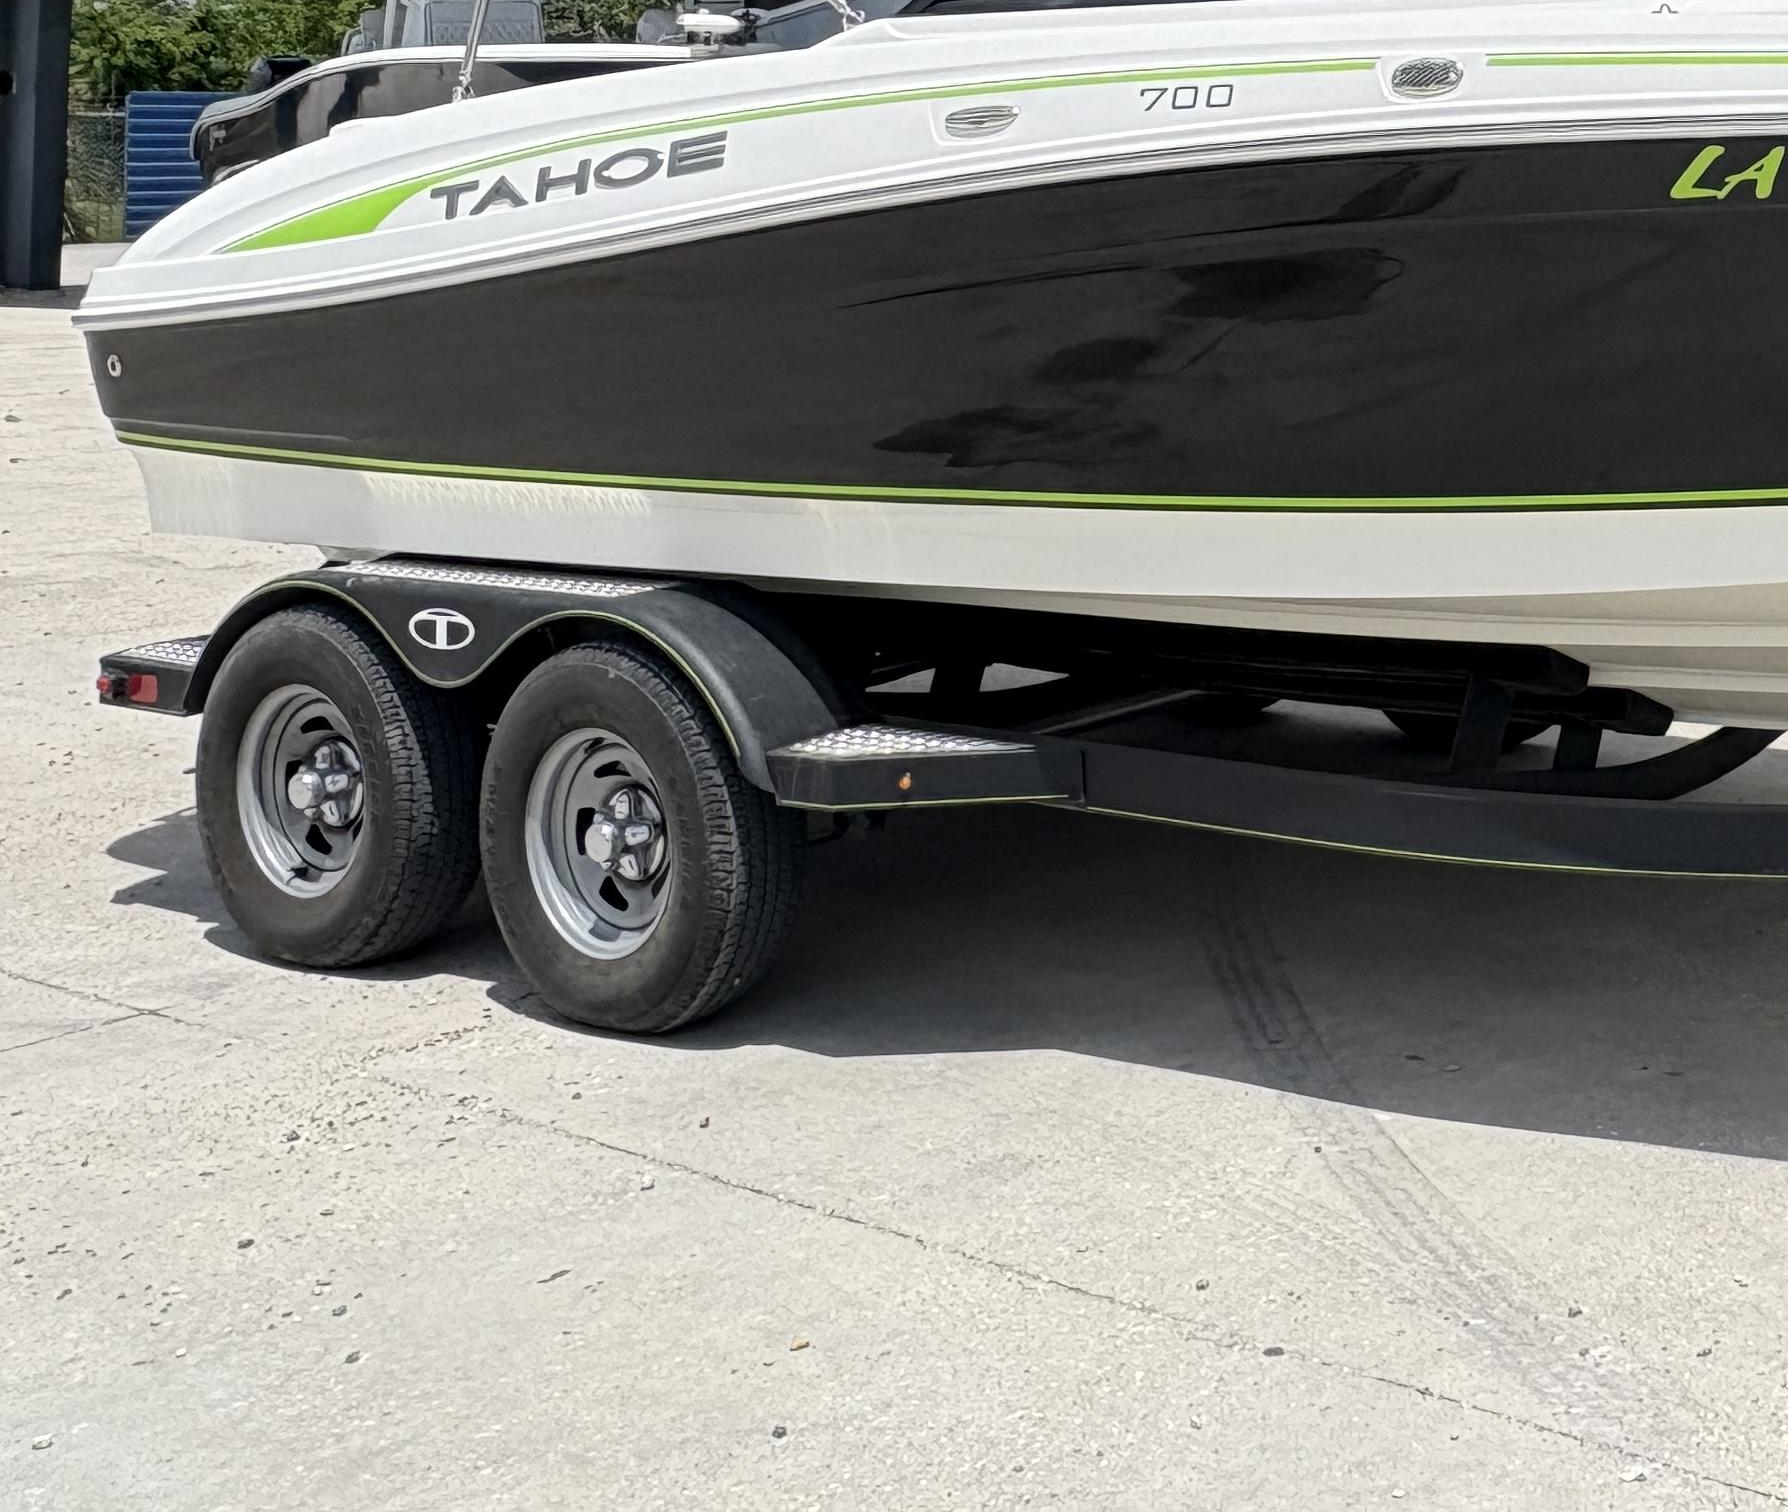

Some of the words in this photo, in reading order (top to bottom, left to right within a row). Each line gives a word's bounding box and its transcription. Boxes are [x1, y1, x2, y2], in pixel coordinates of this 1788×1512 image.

[1140, 84, 1234, 112] 700
[430, 131, 728, 220] TAHOE
[1669, 146, 1785, 200] LA
